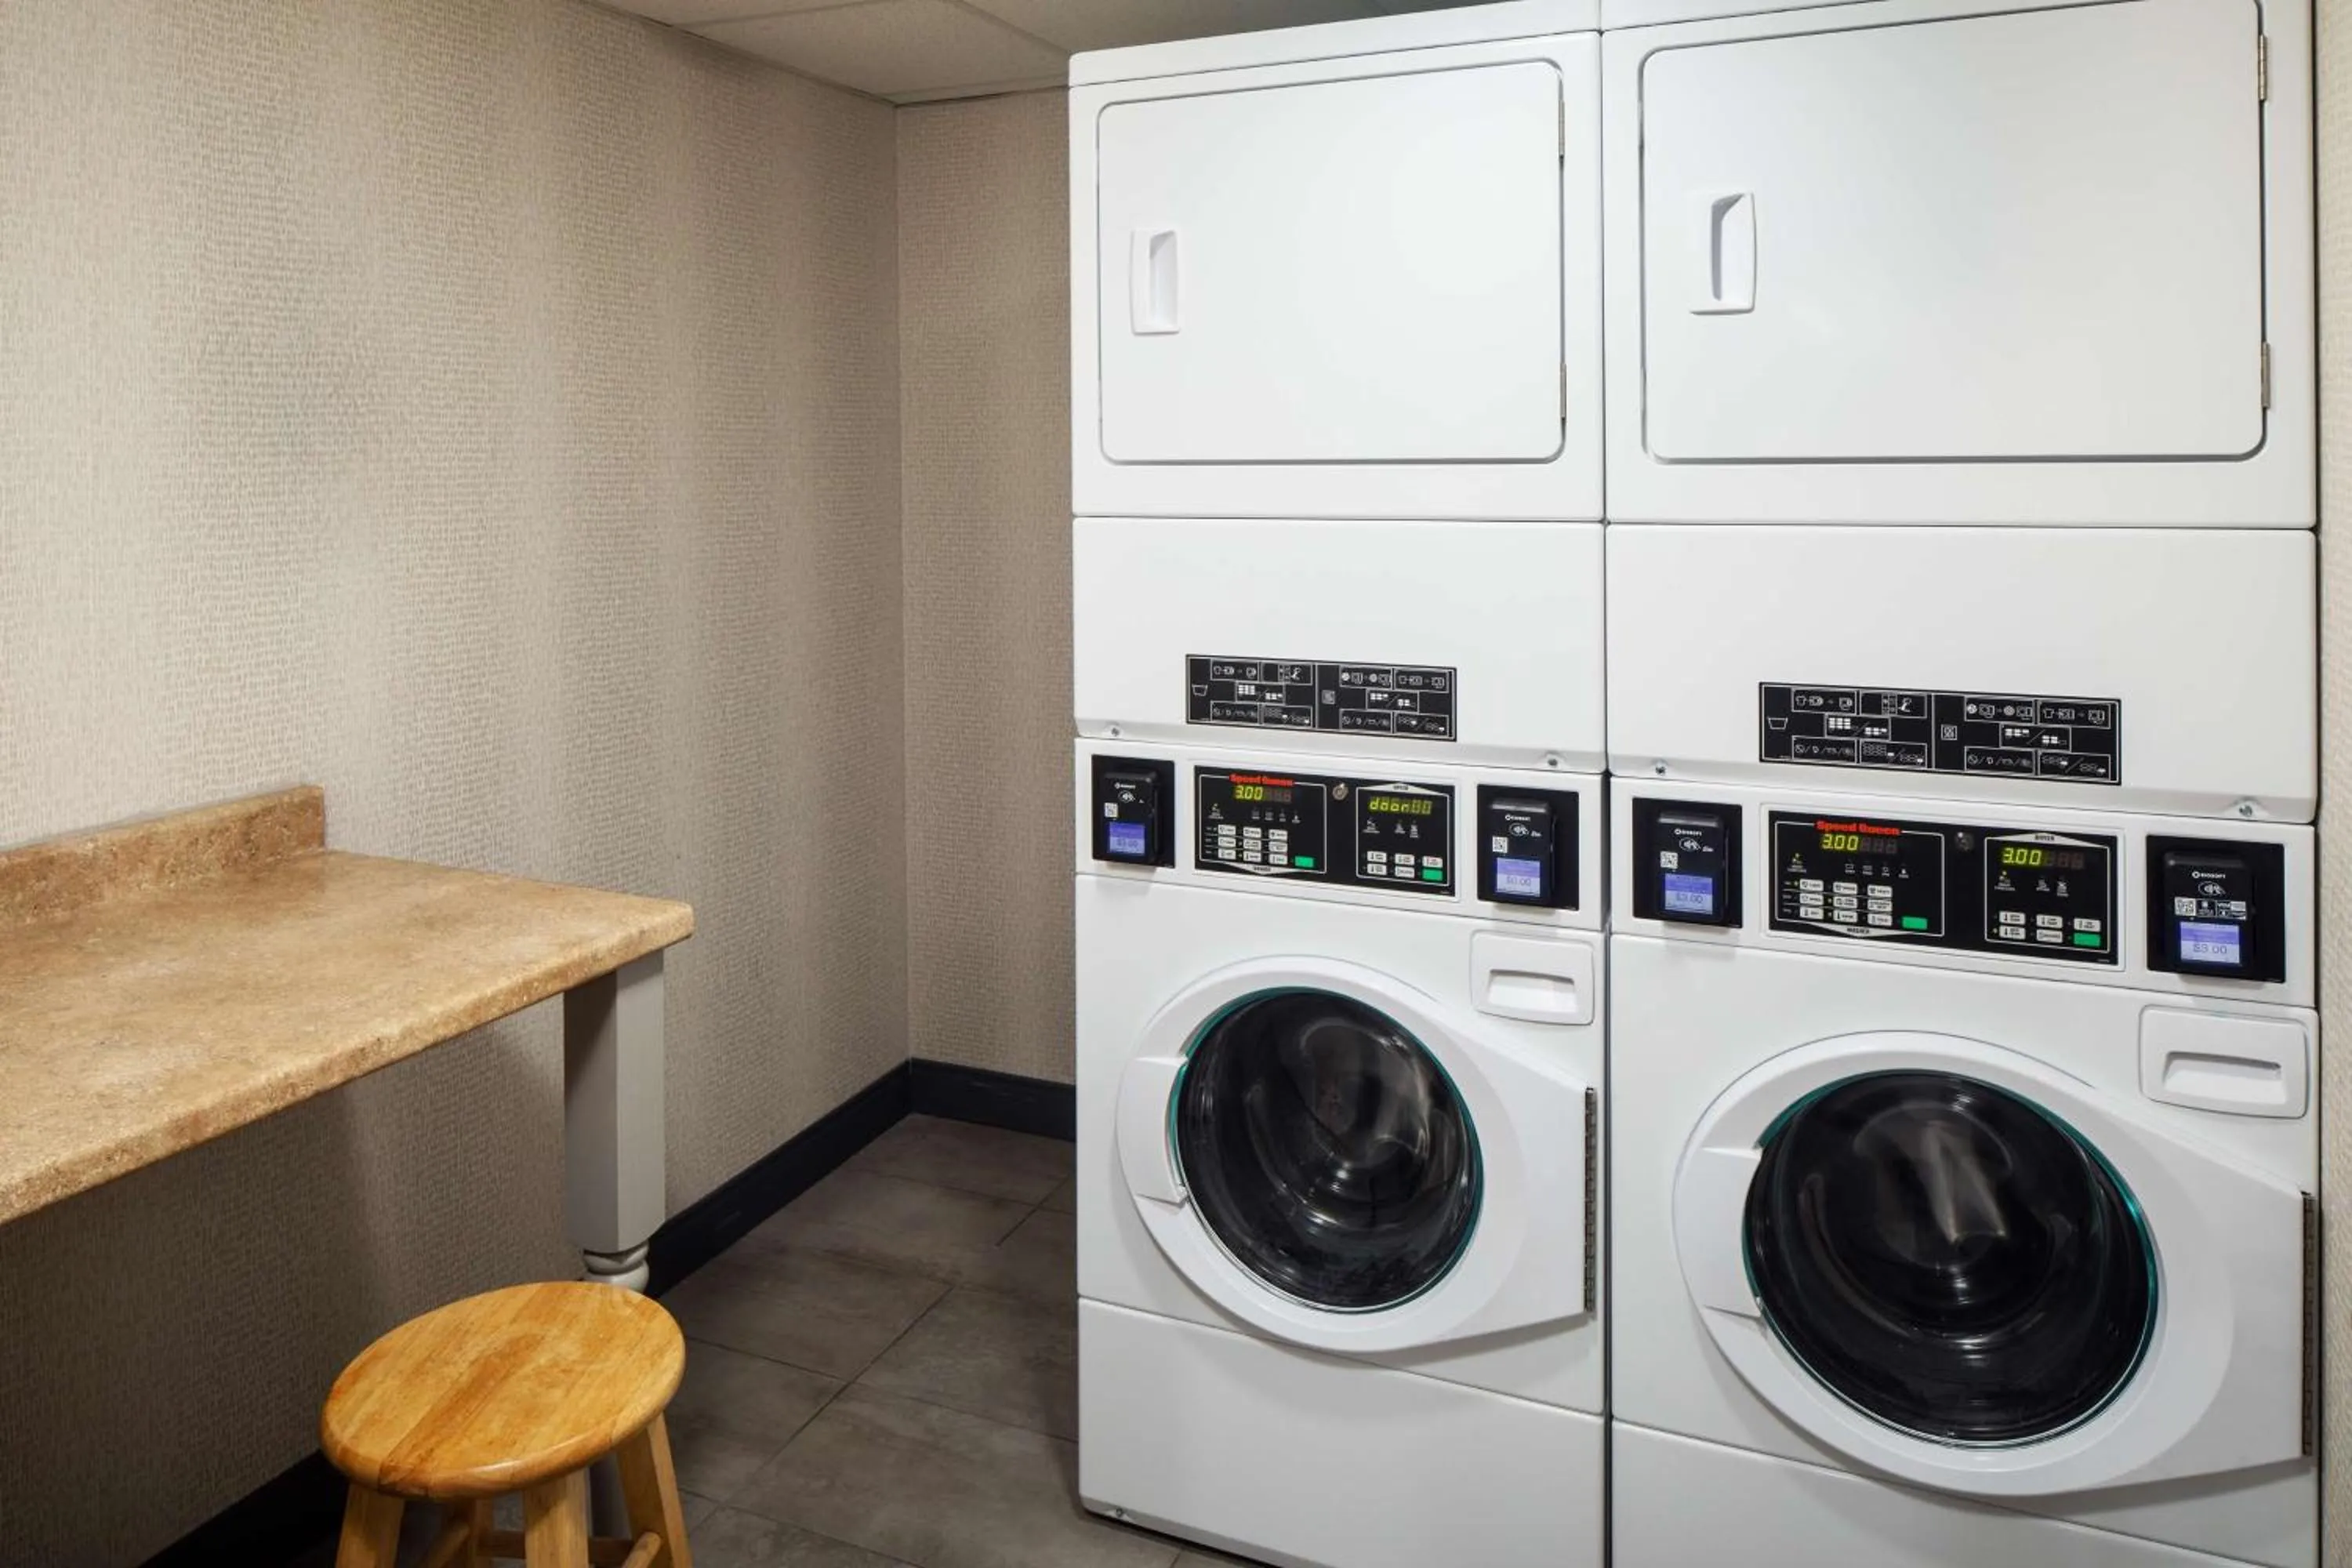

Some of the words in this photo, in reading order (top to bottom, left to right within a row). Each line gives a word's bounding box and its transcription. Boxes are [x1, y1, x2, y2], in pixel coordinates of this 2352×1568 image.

[1816, 821, 1857, 833] Speed
[1822, 833, 1859, 851] 3.00
[2002, 848, 2042, 866] 3.00
